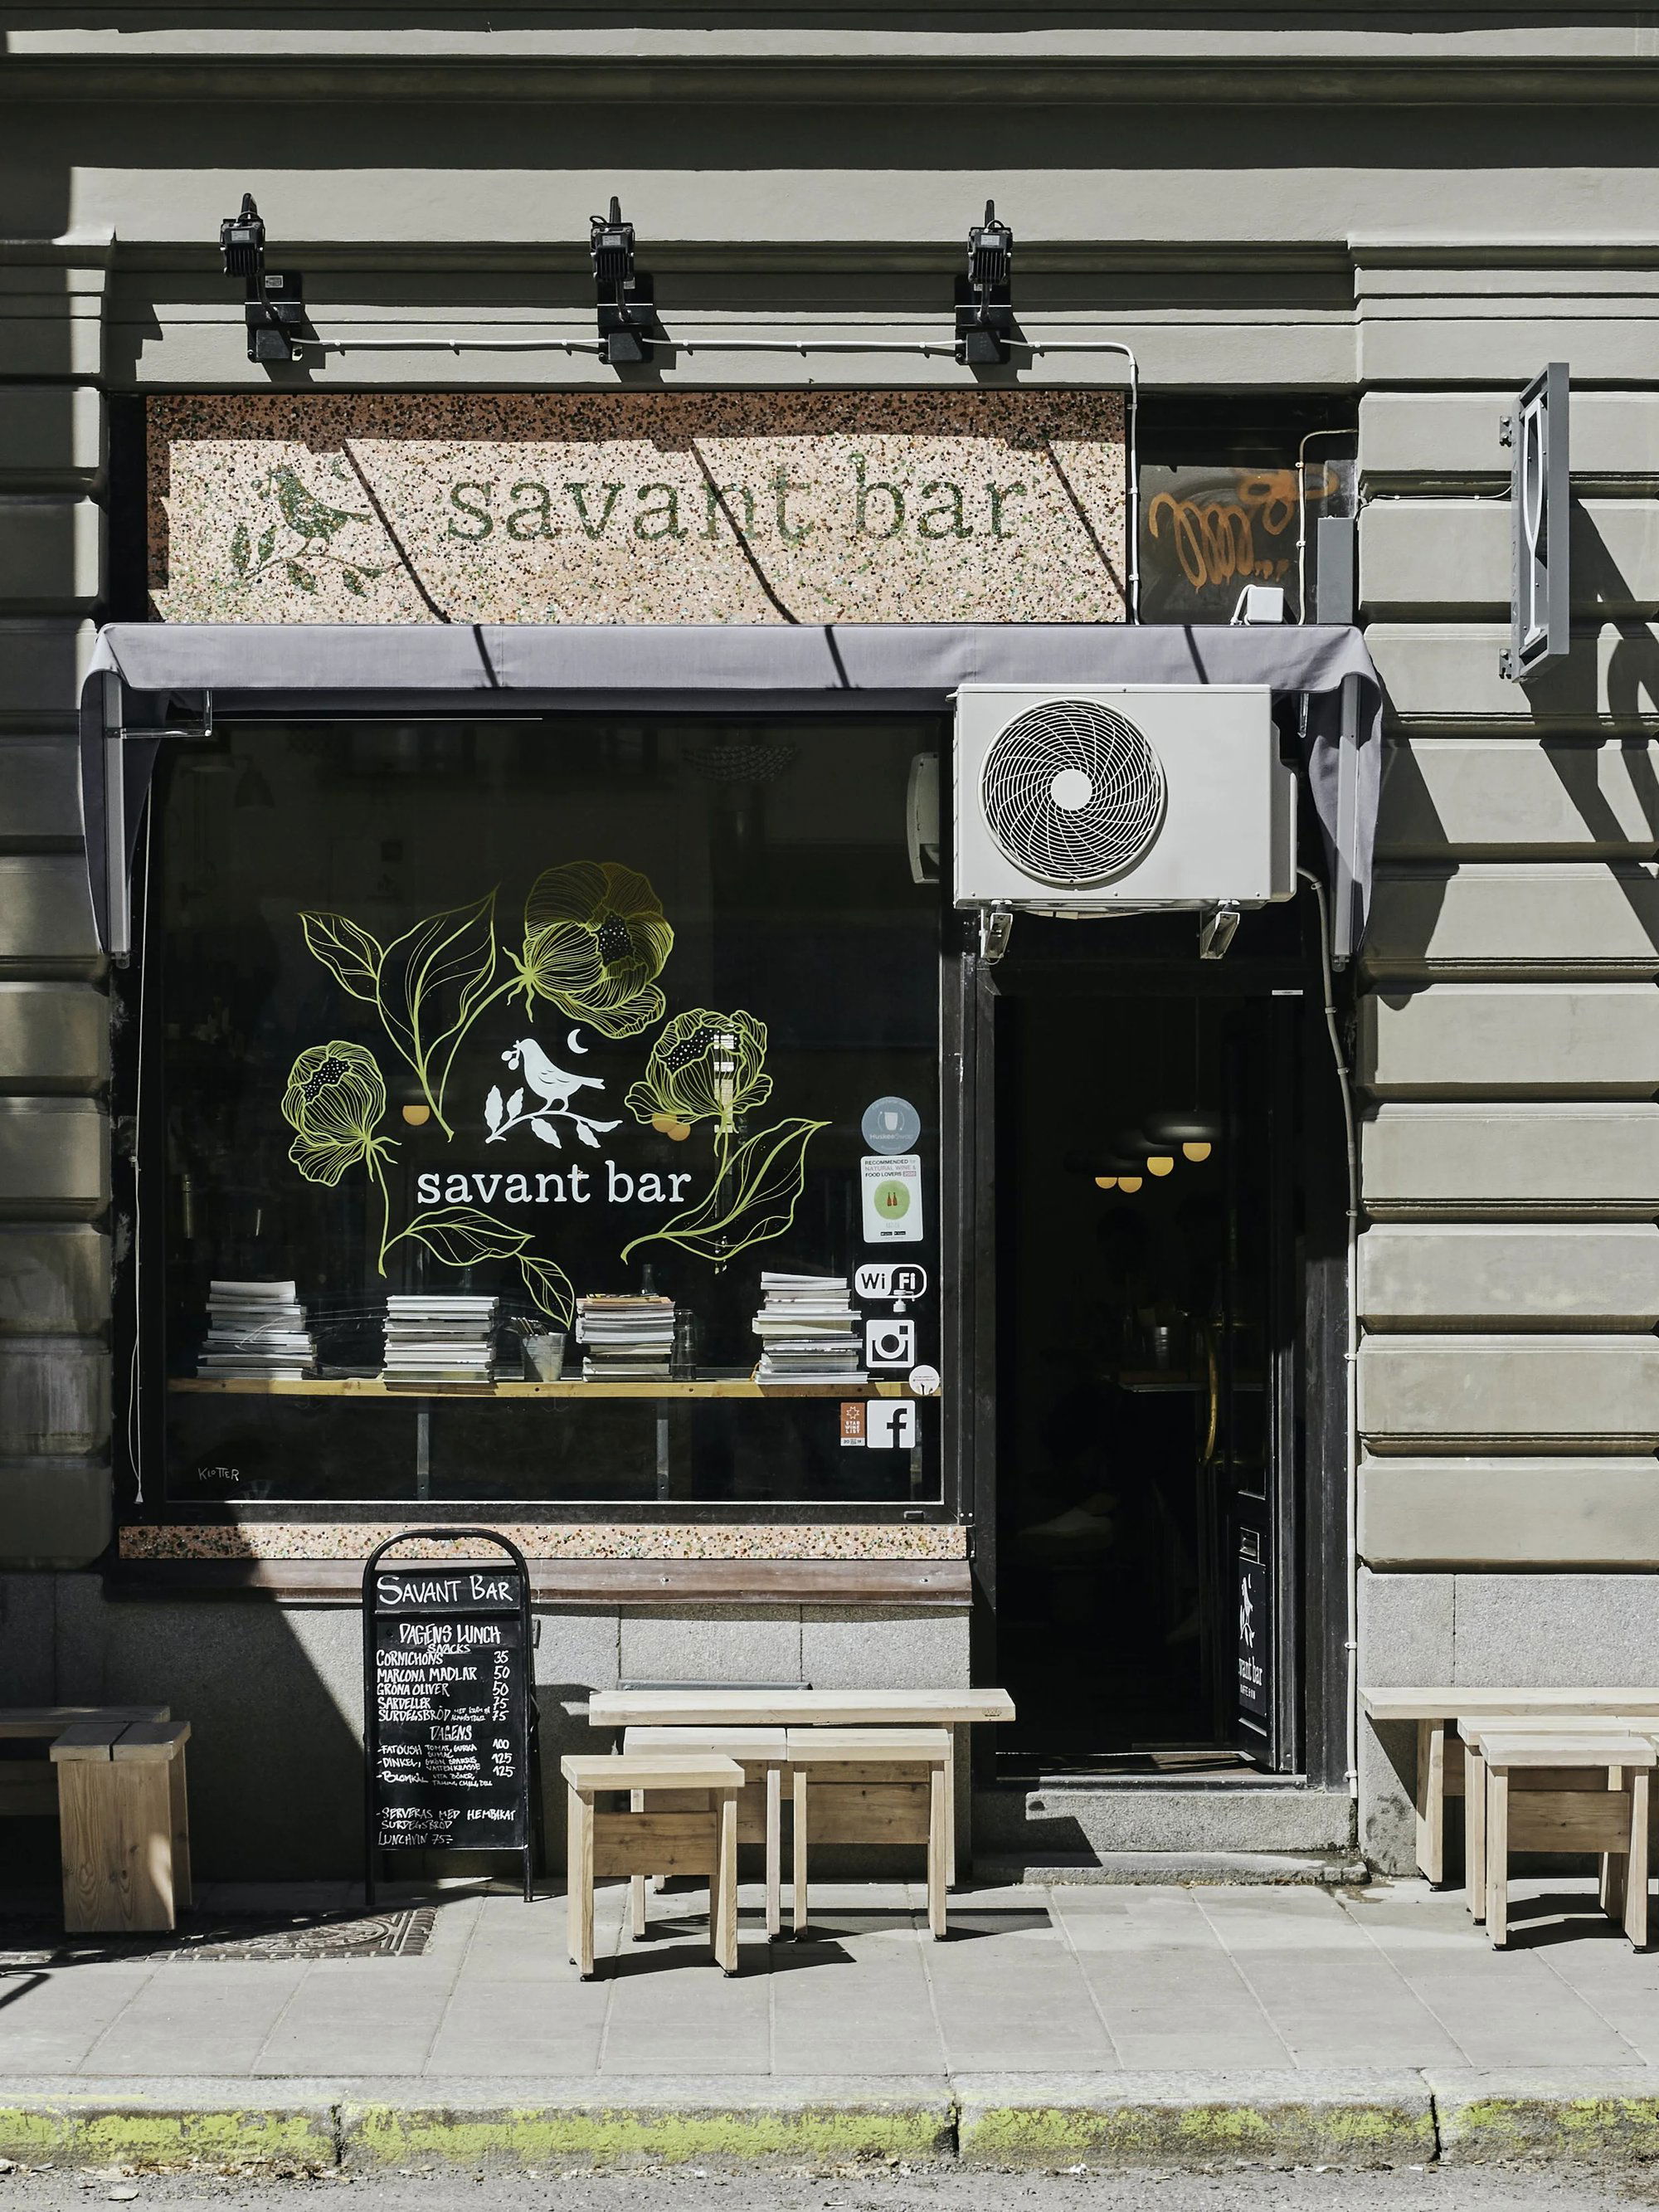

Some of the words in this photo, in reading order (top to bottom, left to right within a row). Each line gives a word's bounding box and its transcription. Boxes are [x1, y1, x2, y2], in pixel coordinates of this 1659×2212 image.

[447, 465, 816, 542] savant
[850, 452, 1029, 540] bar
[417, 1163, 591, 1203] savant
[605, 1160, 692, 1202] bar
[377, 1575, 461, 1605] SAVANT
[469, 1574, 513, 1601] BAR
[399, 1624, 452, 1644] DAGENS
[457, 1624, 501, 1644] LUNCH
[376, 1649, 444, 1666] CORNICHONS
[494, 1650, 509, 1664] 35
[426, 1644, 471, 1654] SNACKS
[377, 1668, 426, 1683] MARCONA
[429, 1667, 478, 1681] MADLAR
[494, 1665, 510, 1679] 50
[1238, 1658, 1252, 1681] vant
[377, 1681, 411, 1696] GRÖNA
[412, 1683, 450, 1697] OLIVER
[493, 1680, 509, 1696] 50
[377, 1697, 431, 1710] SARDELLER
[493, 1696, 509, 1709] 75
[492, 1710, 509, 1722] 75
[430, 1724, 472, 1741] DAGENS
[493, 1738, 509, 1750] 100
[491, 1752, 513, 1764] 125
[493, 1765, 516, 1778] 125
[378, 1831, 428, 1845] LUNCHVIN
